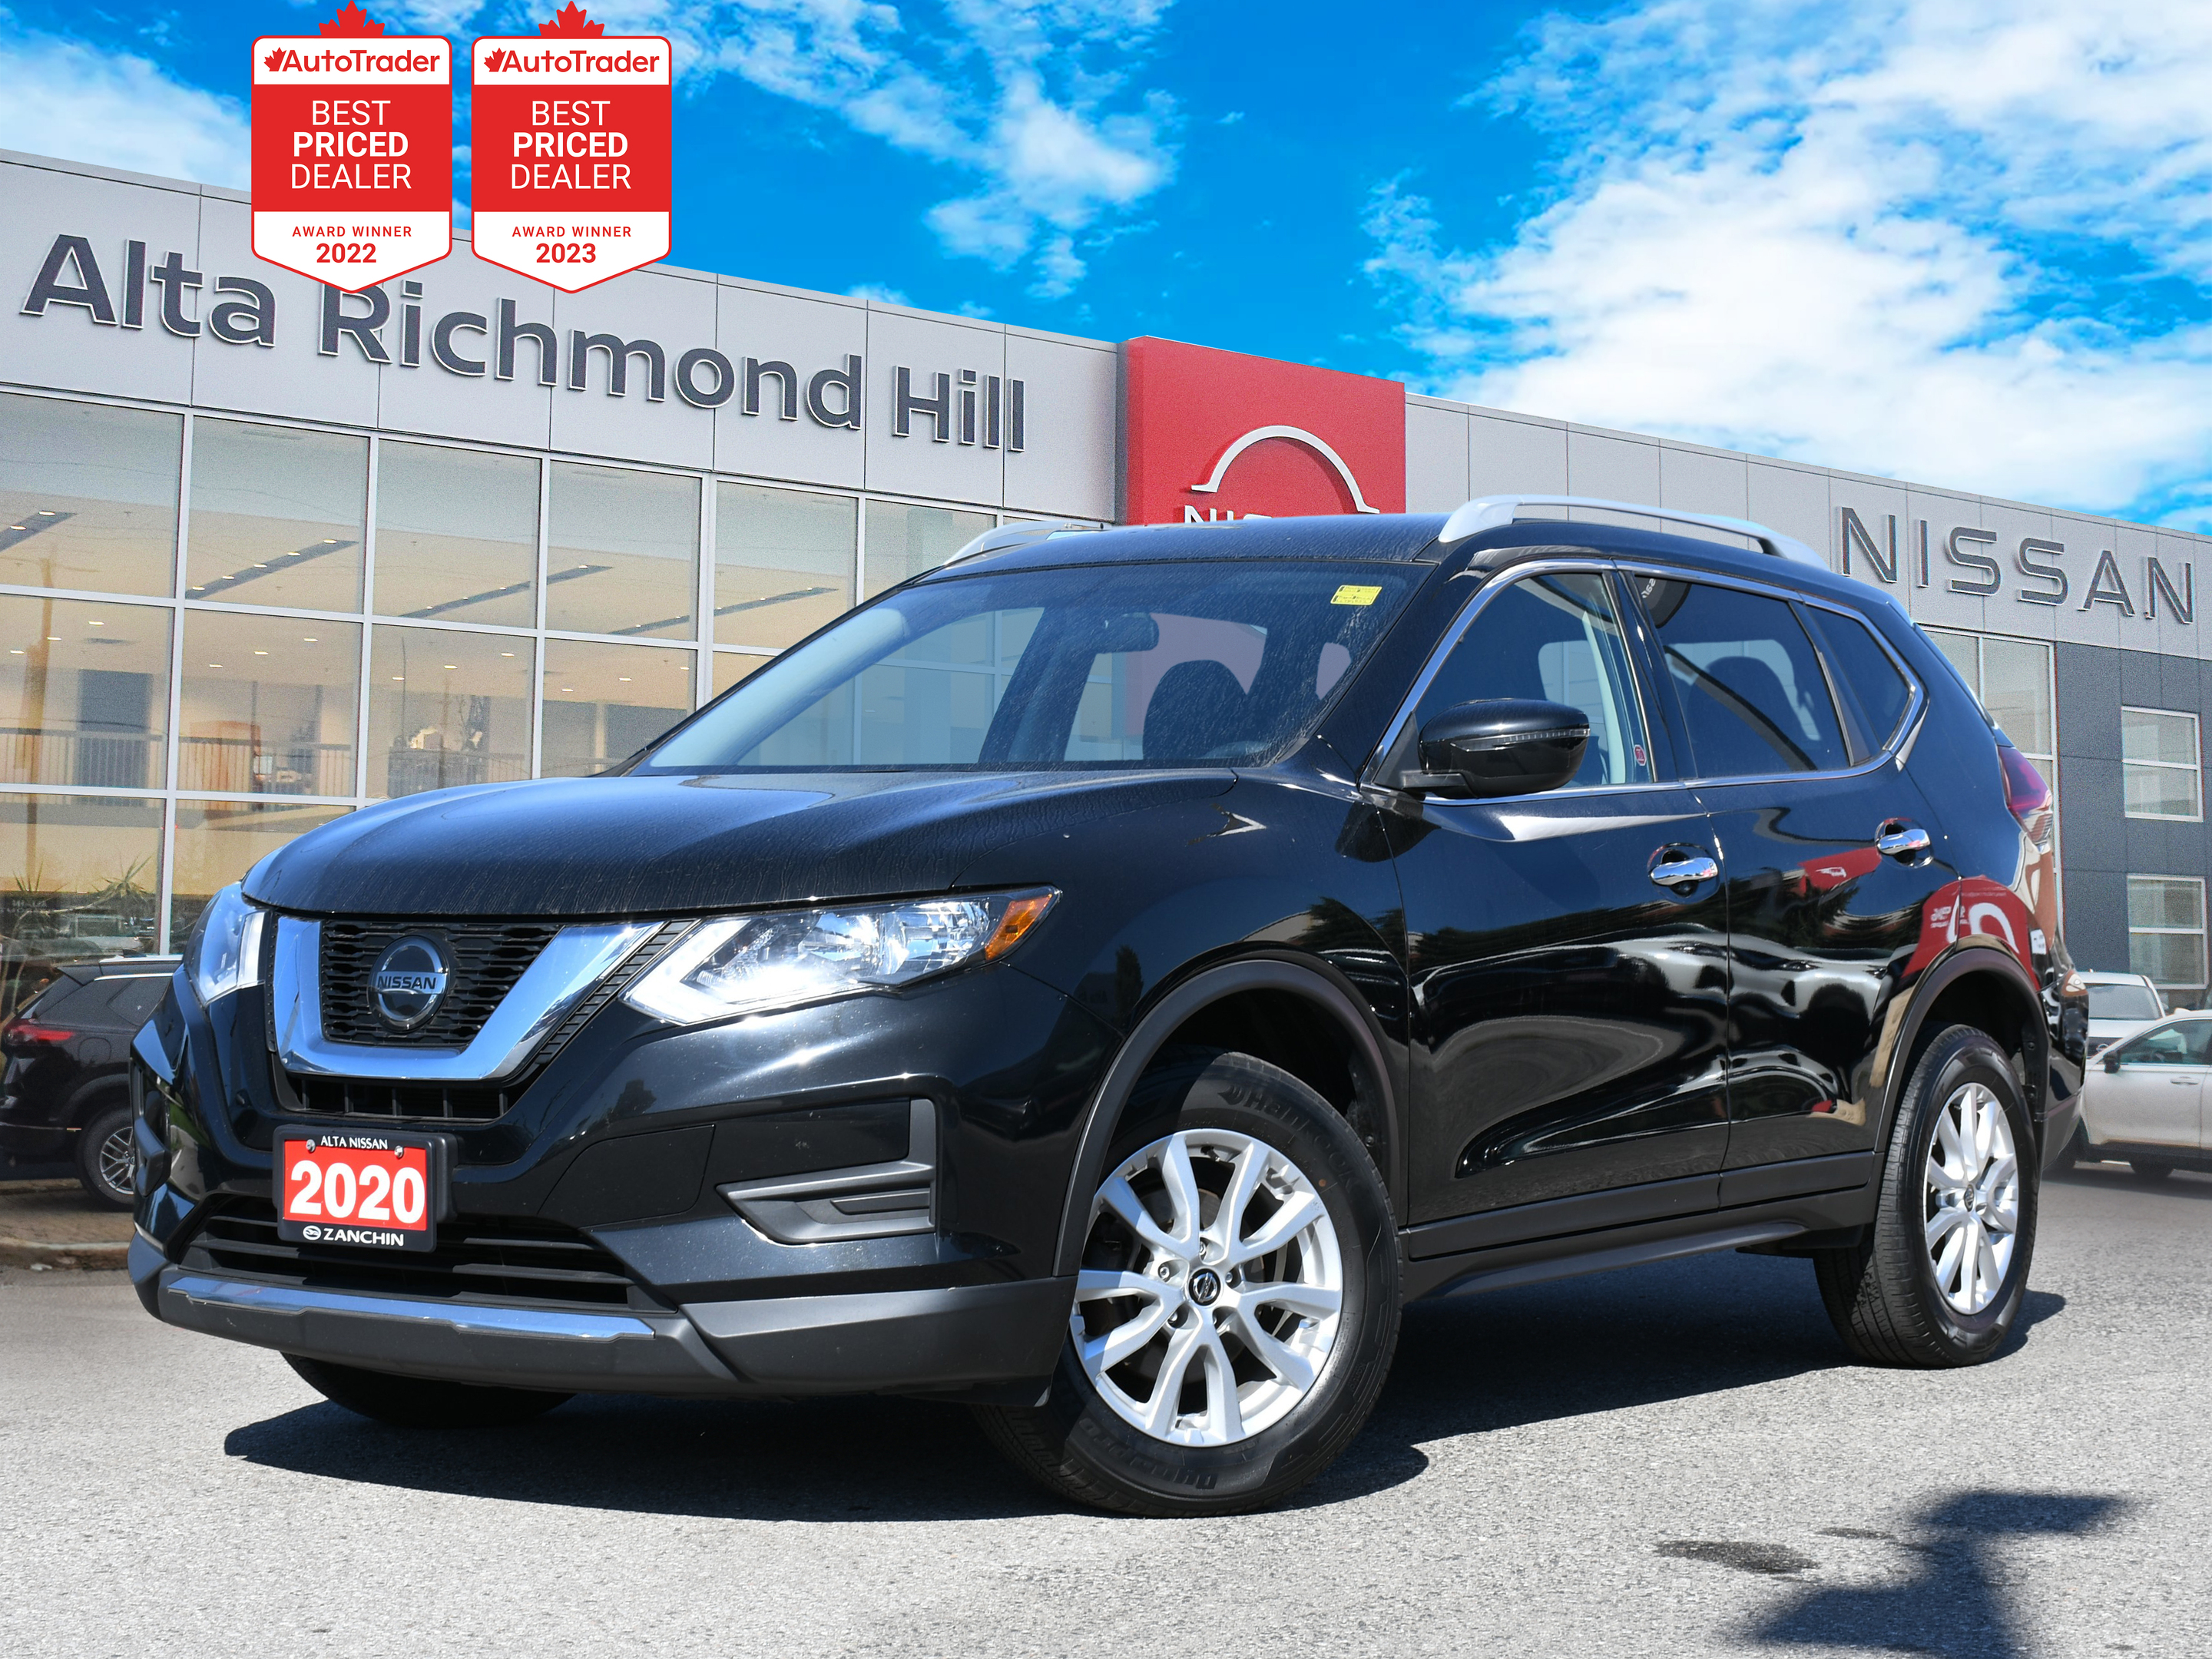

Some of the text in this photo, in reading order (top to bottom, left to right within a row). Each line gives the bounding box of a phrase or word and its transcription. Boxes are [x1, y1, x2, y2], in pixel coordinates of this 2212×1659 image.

[21, 233, 1025, 452] Alta Richmond Hill
[1838, 506, 2194, 624] NISSAN
[377, 975, 436, 990] NISSAN
[320, 1135, 389, 1150] ALTA NISSAN
[290, 1160, 426, 1224] 2020
[323, 1228, 404, 1247] ZANCHIN
